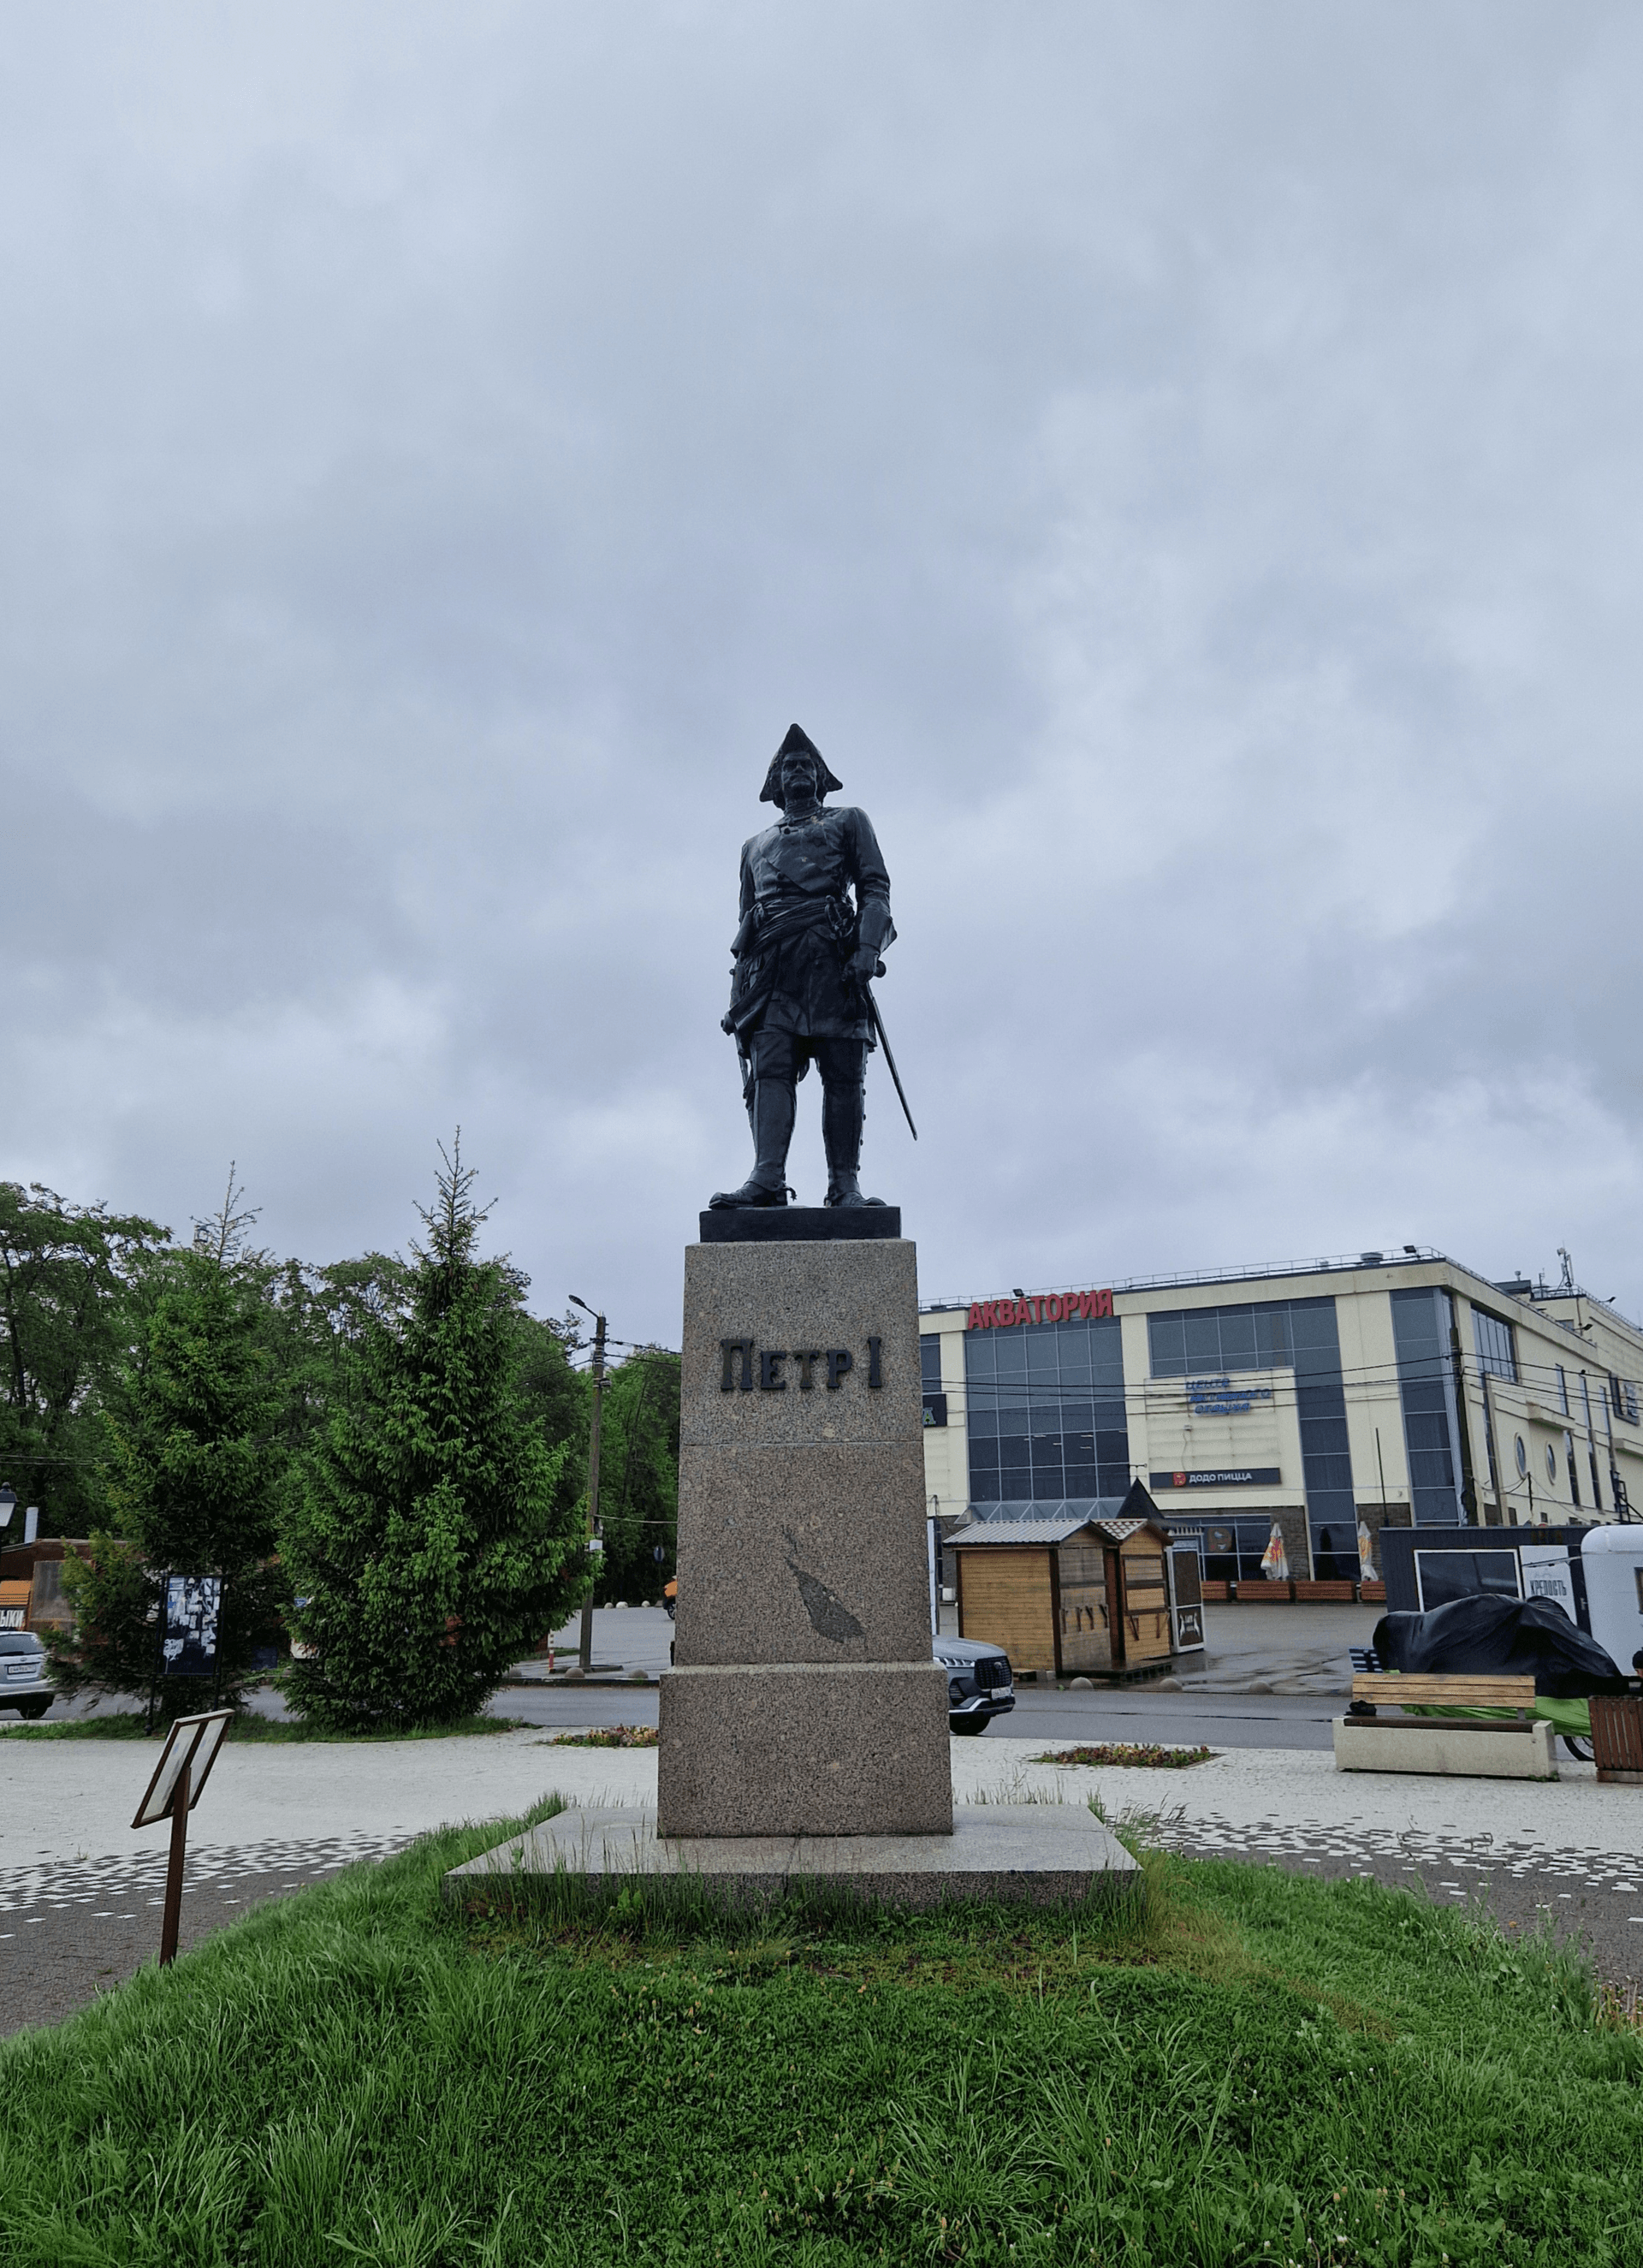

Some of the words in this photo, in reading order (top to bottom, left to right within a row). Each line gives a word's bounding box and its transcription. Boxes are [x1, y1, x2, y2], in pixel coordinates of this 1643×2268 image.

[968, 1288, 1112, 1330] АКВАТОРИЯ
[721, 1339, 852, 1391] ПЕТР
[1189, 1474, 1216, 1484] ДОДО
[1217, 1472, 1253, 1481] ПИЦЦА
